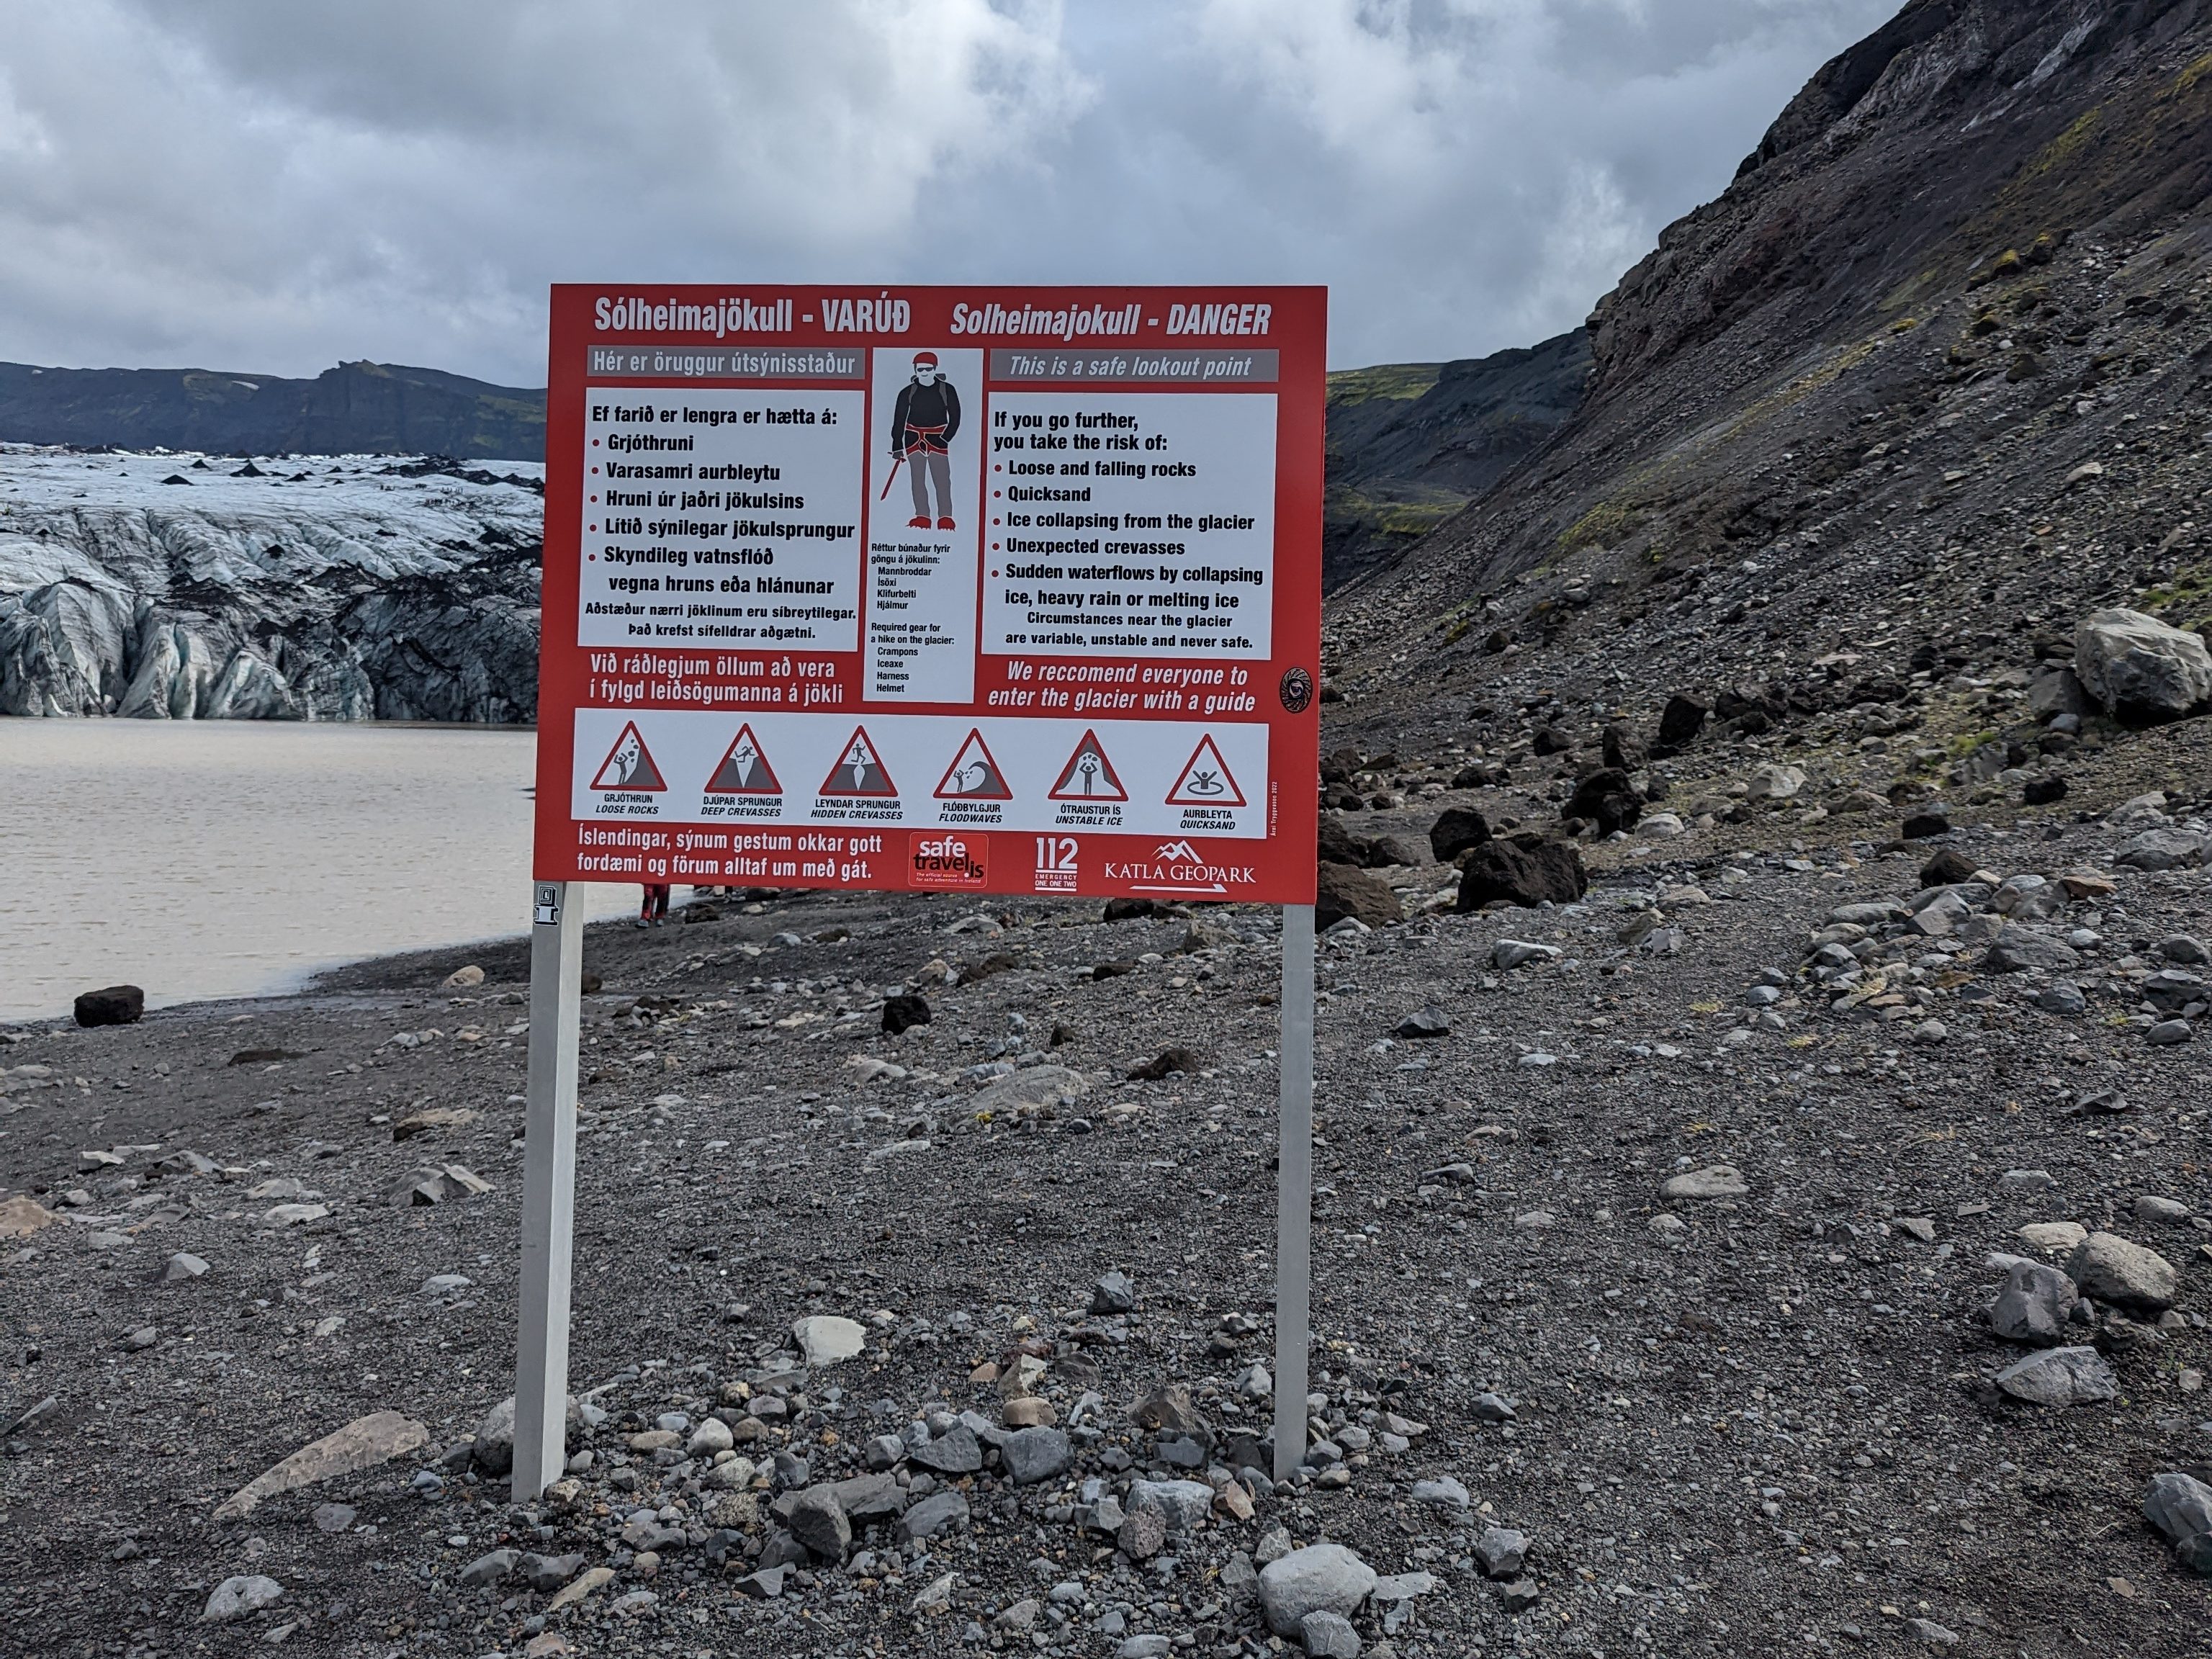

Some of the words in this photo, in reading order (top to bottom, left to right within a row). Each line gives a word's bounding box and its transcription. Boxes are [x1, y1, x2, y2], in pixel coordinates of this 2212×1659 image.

[594, 297, 793, 338] Sólheimajökull
[802, 314, 814, 323] -
[821, 290, 911, 333] VARÚÐ
[950, 302, 1142, 342] Solheimajokull
[1166, 303, 1272, 336] DANGER
[594, 350, 624, 371] Hér
[630, 355, 648, 372] er
[654, 351, 725, 377] öruggur
[732, 351, 855, 377] útsýnisstaður
[1010, 356, 1046, 375] This
[1051, 356, 1068, 376] is
[1072, 360, 1084, 376] a
[1088, 356, 1127, 376] safe
[1131, 356, 1200, 376] lookout
[1202, 356, 1252, 380] point
[593, 405, 610, 422] Ef
[614, 405, 655, 423] farið
[660, 410, 678, 423] er
[683, 407, 737, 427] lengra
[743, 411, 761, 424] er
[766, 408, 815, 425] hætta
[821, 408, 837, 425] á:
[994, 411, 1007, 428] If
[1012, 415, 1043, 431] you
[1048, 415, 1069, 431] go
[1074, 411, 1138, 432] further,
[608, 433, 694, 454] Grjóthruni
[994, 436, 1025, 452] you
[1030, 433, 1068, 449] take
[1073, 433, 1100, 450] the
[1106, 433, 1140, 450] risk
[1145, 434, 1167, 451] of:
[606, 462, 693, 480] Varasamri
[698, 464, 781, 484] aurbleytu
[1009, 459, 1055, 475] Loose
[1060, 460, 1089, 476] and
[1094, 460, 1146, 480] falling
[1151, 462, 1197, 477] rocks
[606, 490, 652, 507] Hruni
[657, 490, 676, 507] úr
[680, 490, 720, 511] jaðri
[724, 491, 804, 512] jökulsins
[1008, 485, 1091, 503] Quicksand
[648, 518, 728, 539] sýnilegar
[732, 520, 855, 541] jökulsprungur
[1007, 511, 1031, 527] Ice
[1036, 512, 1119, 531] collapsing
[1123, 513, 1161, 529] from
[1166, 513, 1193, 529] the
[1198, 514, 1255, 533] glacier
[604, 546, 688, 567] Skyndileg
[693, 547, 773, 565] vatnsflóð
[871, 542, 896, 552] Réttur
[898, 543, 932, 553] búnaður
[933, 544, 951, 554] fyrir
[1007, 537, 1099, 557] Unexpected
[1104, 542, 1185, 555] crevasses
[871, 554, 896, 565] göngu
[898, 554, 904, 564] á
[904, 554, 940, 565] jökulinn:
[878, 566, 932, 576] Mannbroddar
[1005, 563, 1063, 579] Sudden
[1067, 565, 1155, 581] waterflows
[1159, 565, 1179, 584] by
[1182, 566, 1263, 585] collapsing
[608, 577, 660, 594] vegna
[665, 575, 714, 593] hruns
[720, 575, 750, 593] eða
[757, 576, 835, 594] hlánunar
[877, 575, 897, 587] Ísöxi
[877, 589, 917, 598] Klifurbelti
[1005, 589, 1033, 608] ice,
[1038, 589, 1085, 608] heavy
[1089, 590, 1121, 606] rain
[1126, 594, 1144, 606] or
[1148, 592, 1210, 611] melting
[1215, 593, 1239, 608] ice
[876, 600, 909, 611] Hjálmur
[871, 622, 907, 633] Required
[909, 624, 927, 634] gear
[929, 623, 941, 632] for
[878, 634, 896, 644] hike
[909, 635, 923, 644] the
[925, 635, 955, 646] glacier:
[877, 647, 919, 657] Crampons
[590, 652, 617, 673] Við
[624, 652, 710, 679] ráðlegjum
[716, 656, 764, 676] öllum
[770, 655, 791, 677] að
[797, 662, 835, 678] vera
[877, 659, 904, 668] Iceaxe
[876, 671, 909, 680] Harness
[1007, 660, 1033, 680] We
[1038, 663, 1138, 683] reccomend
[1142, 667, 1224, 688] everyone
[1230, 666, 1248, 685] to
[590, 678, 595, 698] í
[601, 679, 644, 703] fylgd
[651, 679, 781, 705] leiðsögumanna
[788, 682, 798, 703] á
[803, 683, 842, 707] jökli
[876, 683, 905, 693] Helmet
[988, 687, 1036, 706] enter
[1040, 687, 1069, 707] the
[1074, 688, 1138, 711] glacier
[1143, 689, 1182, 710] with
[1187, 694, 1199, 710] a
[1204, 691, 1256, 715] guide
[604, 791, 653, 804] GRJÓTHRUN
[703, 794, 736, 806] DJÚPAR
[737, 796, 783, 807] SPRUNGUR
[815, 799, 853, 809] LEYNDAR
[855, 799, 901, 809] SPRUNGUR
[943, 801, 1001, 813] FLÓÐBYLGJUR
[595, 804, 626, 814] LOOSE
[627, 805, 660, 815] ROCKS
[701, 806, 726, 816] DEEP
[727, 807, 782, 817] CREVASSES
[810, 809, 847, 819] HIDDEN
[848, 810, 904, 820] CREVASSES
[1060, 802, 1110, 815] ÓTRAUSTUR
[1112, 804, 1121, 815] ÍS
[1182, 809, 1233, 819] AURBLEYTA
[938, 813, 1003, 824] FLOODWAVES
[1055, 815, 1105, 825] UNSTABLE
[1106, 817, 1123, 826] ICE
[1179, 819, 1236, 830] QUICKSAND
[578, 822, 671, 851] Íslendingar,
[676, 829, 727, 852] sýnum
[734, 832, 792, 853] gestum
[798, 832, 844, 852] okkar
[849, 835, 882, 856] gott
[920, 835, 966, 858] safe
[1036, 837, 1079, 870] 112
[577, 852, 642, 872] fordæmi
[647, 858, 667, 877] og
[672, 855, 719, 874] förum
[724, 857, 768, 876] alltaf
[773, 862, 796, 876] um
[802, 858, 835, 878] með
[841, 859, 872, 882] gát.
[1105, 863, 1166, 880] KATLA
[1170, 865, 1256, 884] GEOPARK
